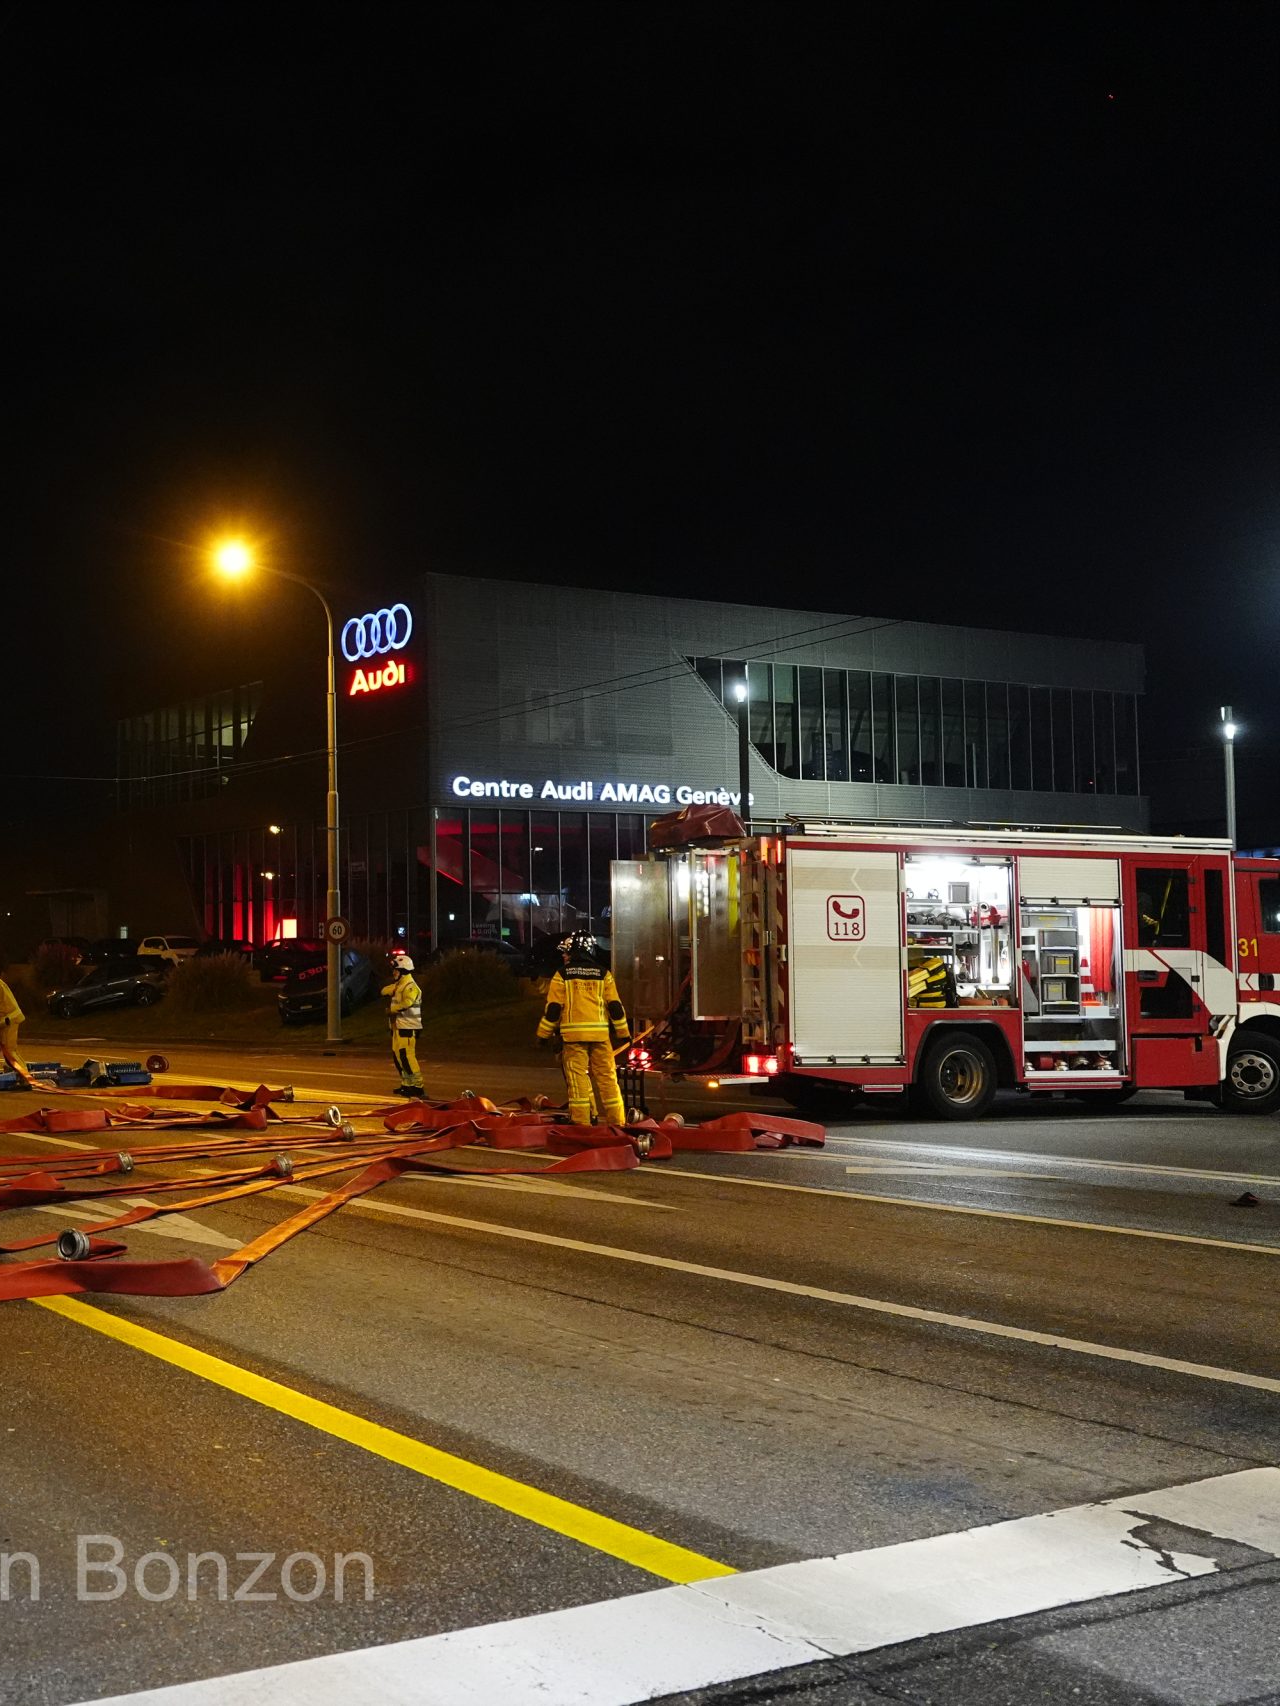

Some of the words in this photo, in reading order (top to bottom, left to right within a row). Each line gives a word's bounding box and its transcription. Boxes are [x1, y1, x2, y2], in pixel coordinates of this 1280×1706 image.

[349, 660, 406, 696] Audi
[452, 776, 534, 799] Centre
[540, 780, 593, 801] Audi
[600, 783, 671, 804] AMAG
[332, 925, 343, 936] 60
[833, 922, 860, 936] 118
[1237, 937, 1259, 957] 31
